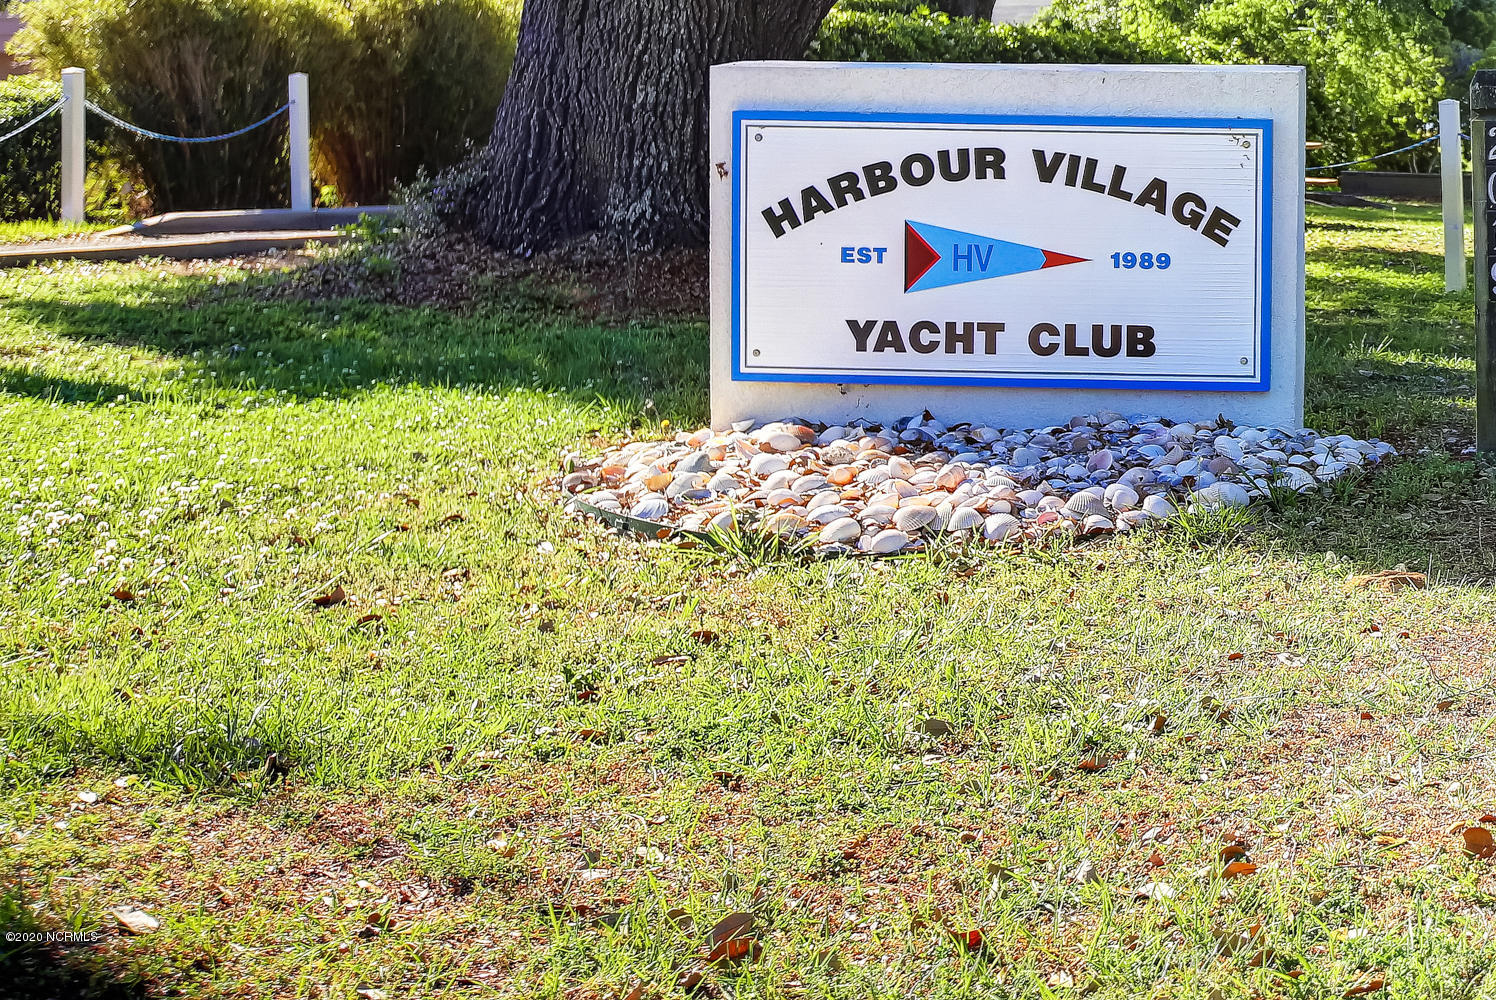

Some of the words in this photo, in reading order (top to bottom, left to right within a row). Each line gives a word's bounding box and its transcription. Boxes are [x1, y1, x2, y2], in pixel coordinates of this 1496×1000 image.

[761, 147, 1006, 239] HARBOUR
[1032, 149, 1241, 247] VILLAGE
[840, 247, 887, 265] EST
[952, 243, 994, 273] HV
[1110, 252, 1172, 270] 1989
[846, 320, 1005, 355] YACHT
[1028, 322, 1156, 358] CLUB
